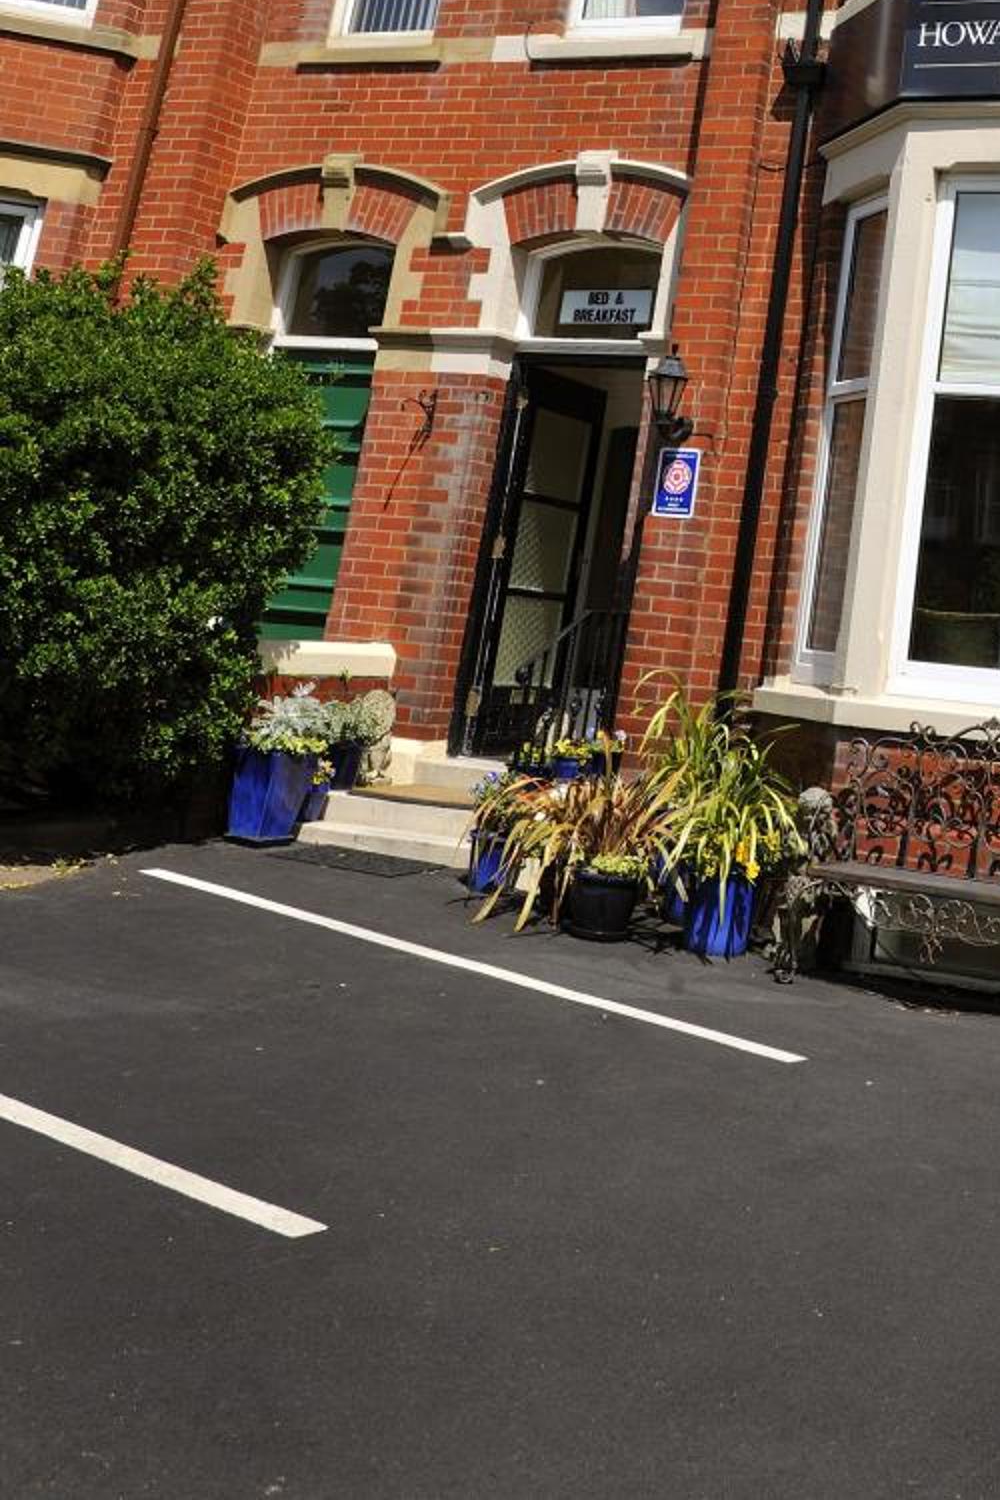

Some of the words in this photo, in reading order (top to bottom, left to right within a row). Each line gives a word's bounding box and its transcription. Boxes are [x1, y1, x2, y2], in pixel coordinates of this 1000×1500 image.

[588, 292, 609, 304] BED
[614, 292, 624, 304] &
[573, 308, 636, 323] BREAKFAST
